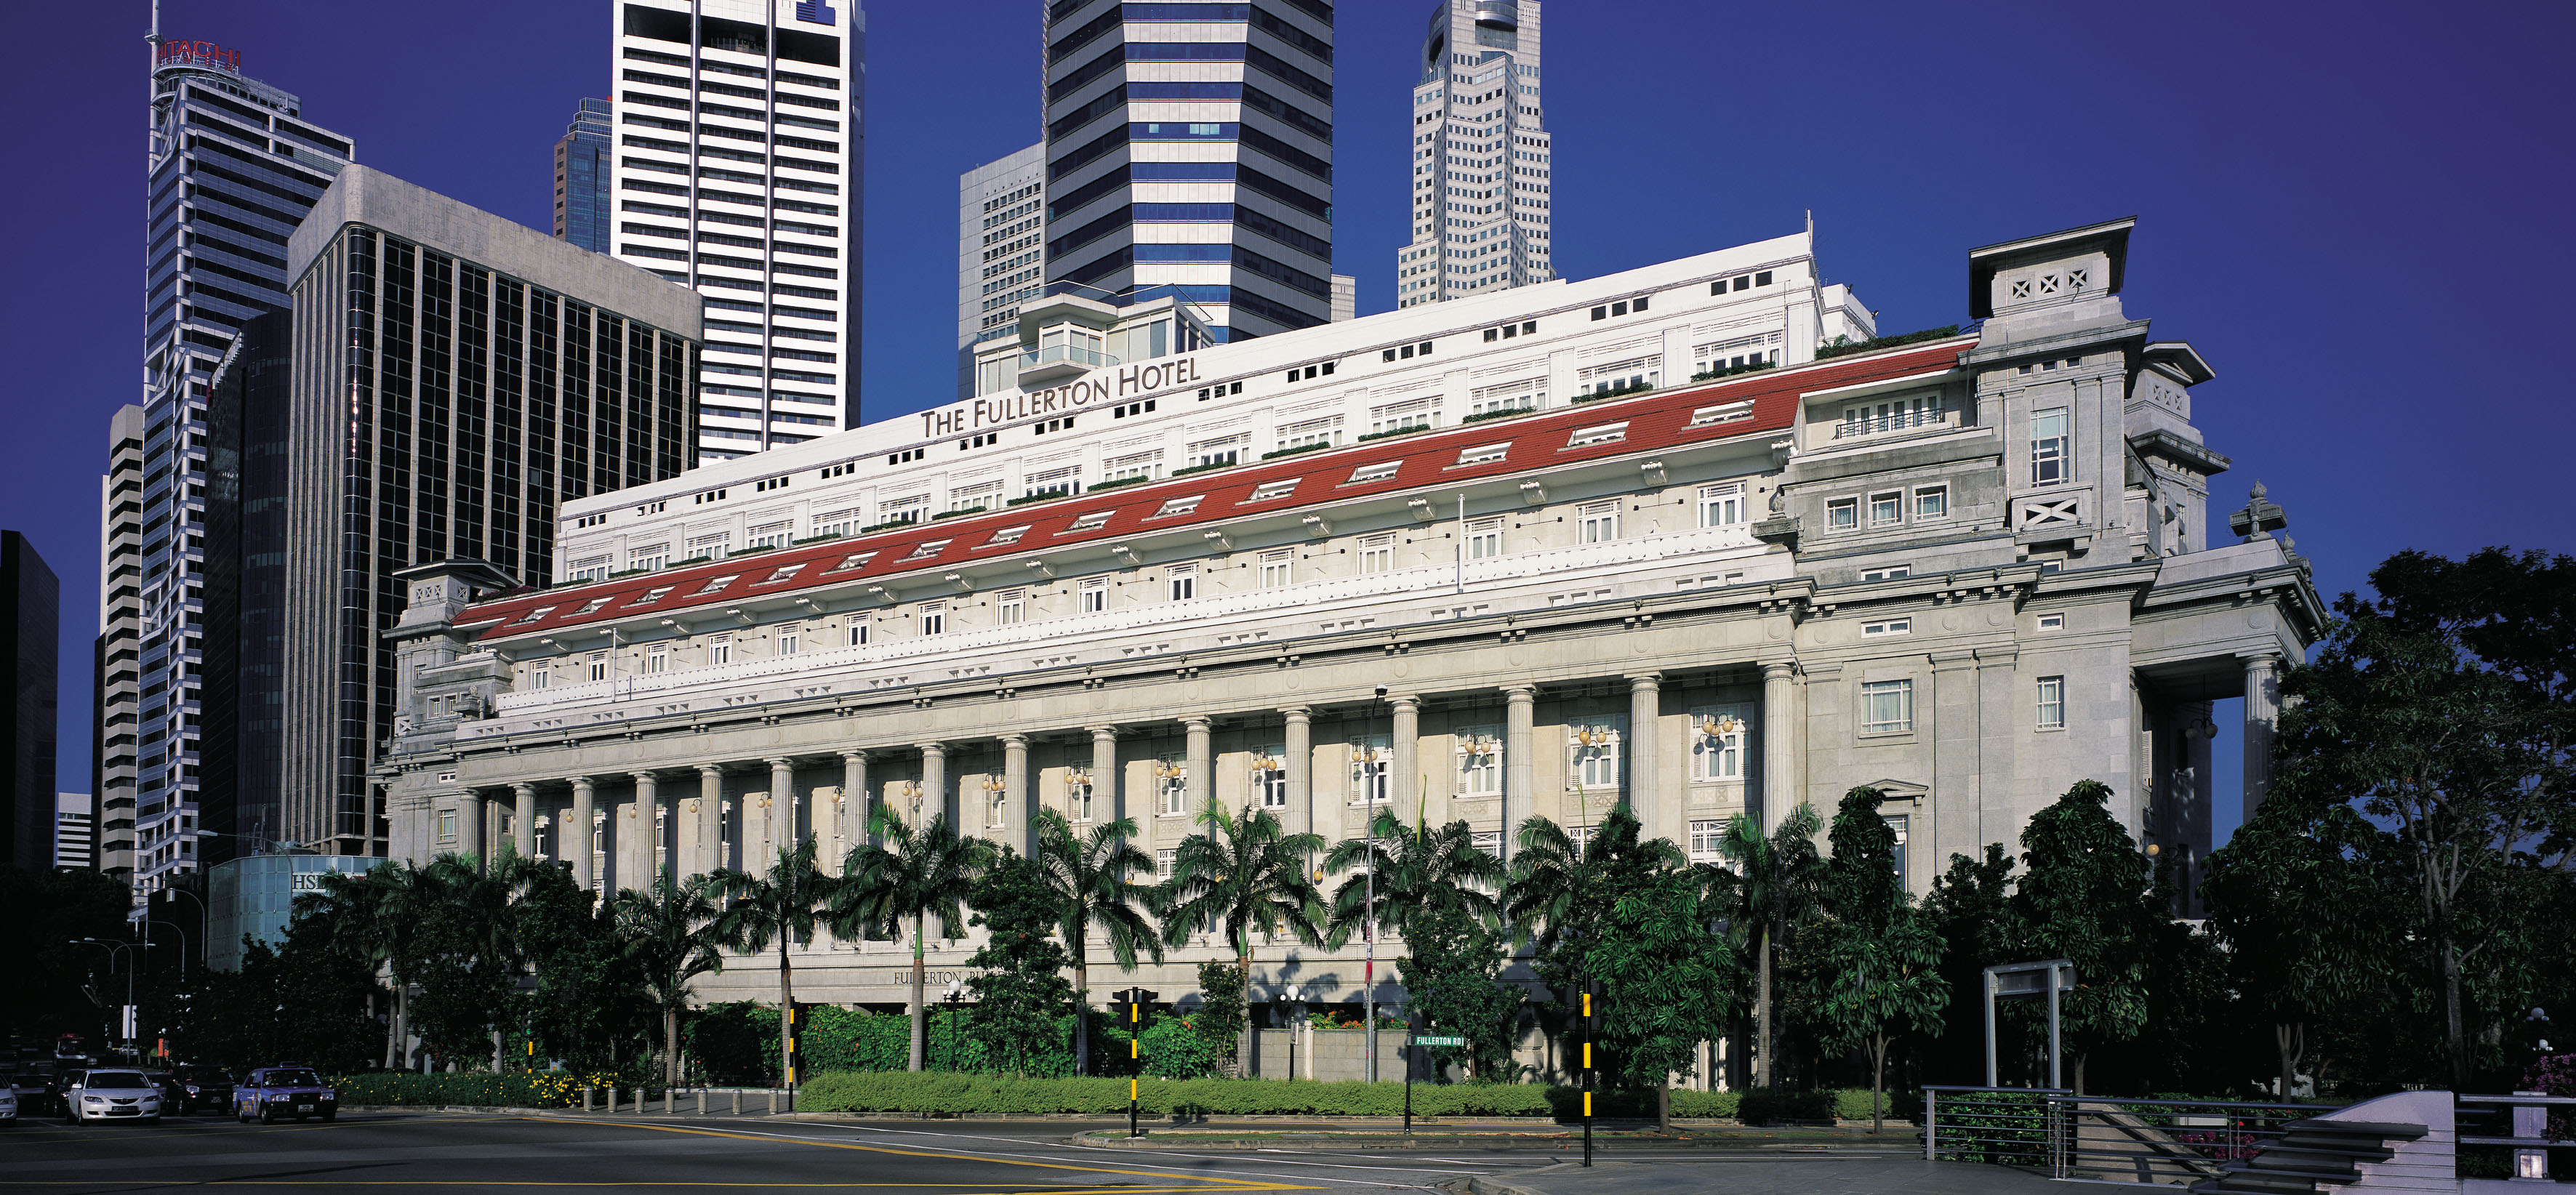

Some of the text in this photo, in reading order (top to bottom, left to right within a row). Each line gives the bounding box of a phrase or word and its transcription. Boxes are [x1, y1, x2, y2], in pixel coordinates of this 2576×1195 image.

[157, 40, 241, 67] HITACHI
[921, 358, 1200, 438] THE FULLERTON HOTEL
[894, 971, 962, 984] FULERTON
[1416, 1037, 1451, 1045] FULLERTON
